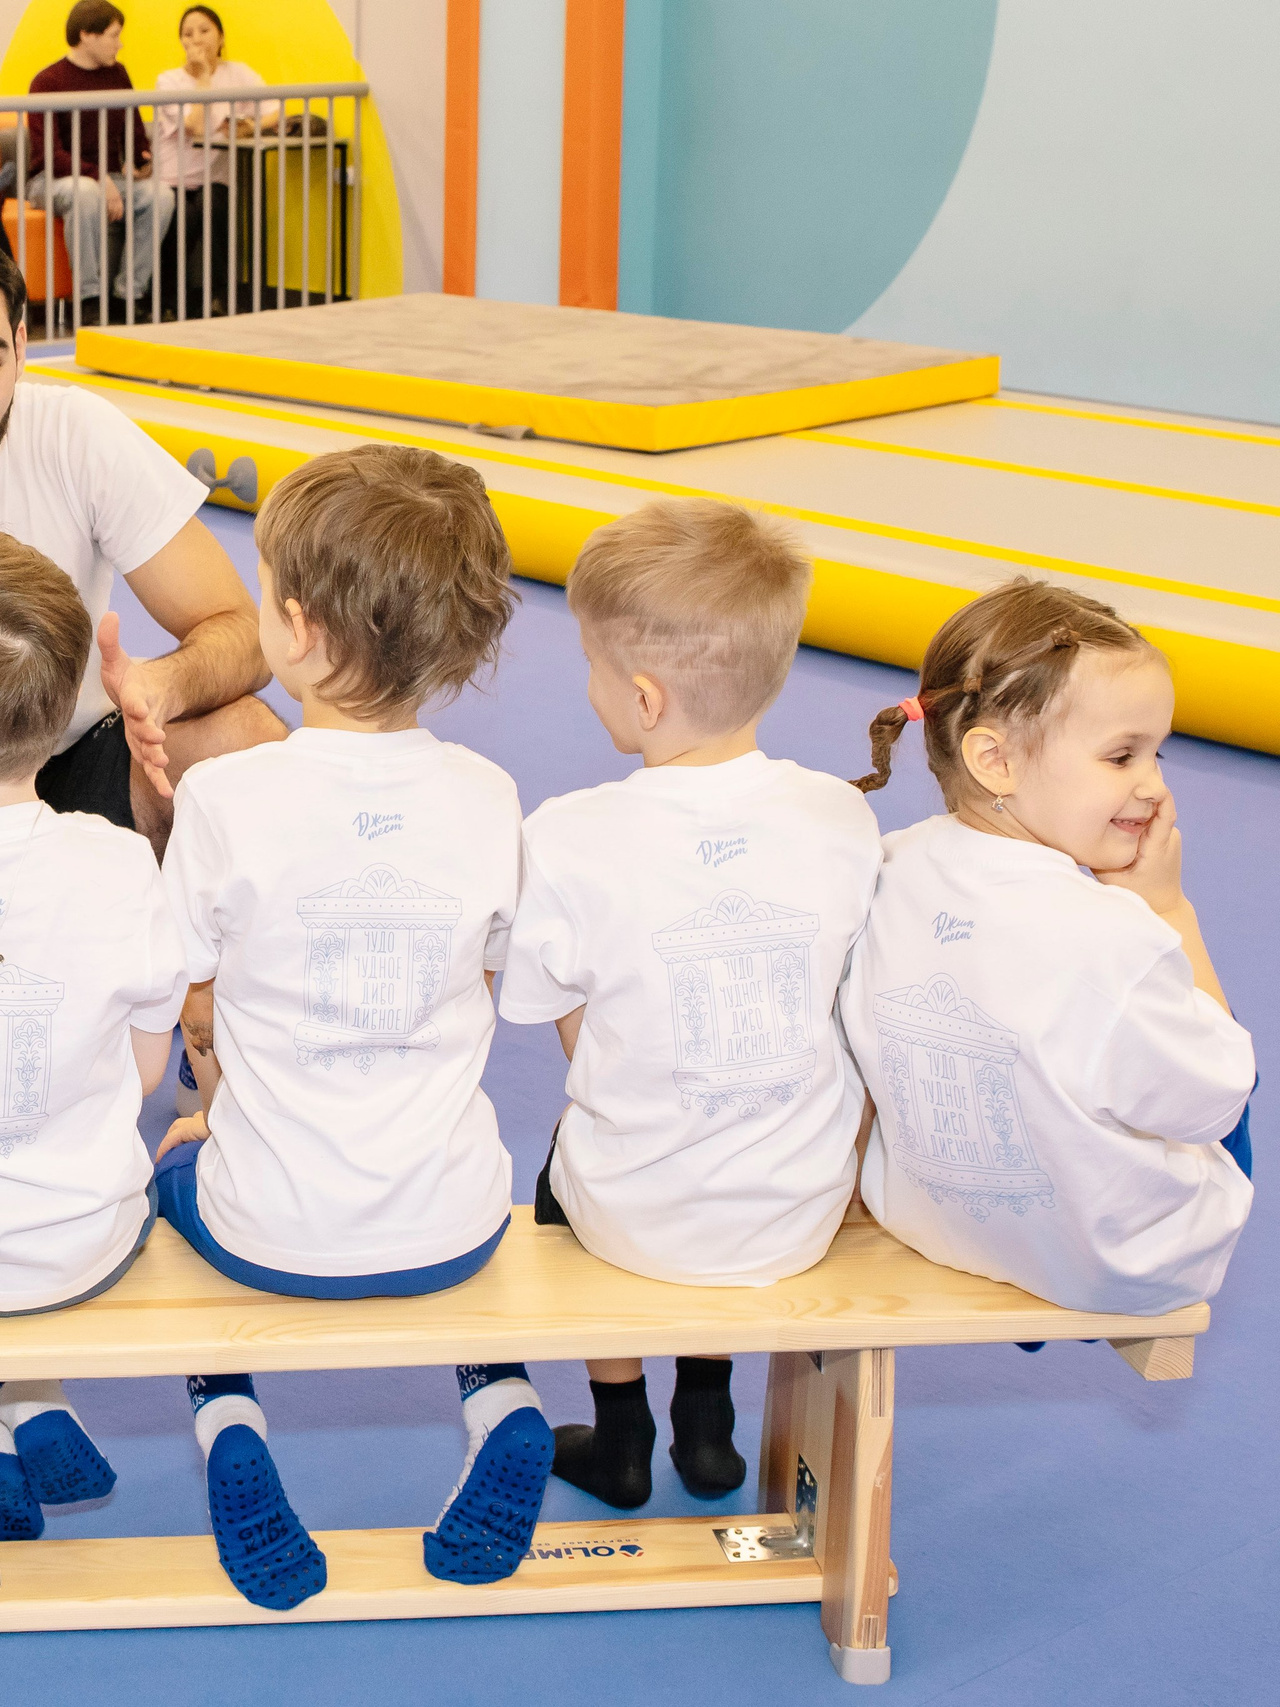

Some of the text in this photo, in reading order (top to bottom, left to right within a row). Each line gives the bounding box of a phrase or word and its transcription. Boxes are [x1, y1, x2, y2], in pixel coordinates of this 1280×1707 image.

[364, 931, 395, 954] ЧУДО
[354, 955, 402, 979] ЧУДНОЕ
[722, 956, 754, 981] ЧУДО
[719, 980, 764, 1009] ЧУДНОЕ
[925, 1051, 958, 1081] ЧУДО
[919, 1078, 970, 1112] ЧУДНОЕ
[238, 1510, 282, 1541] GYM
[489, 1501, 534, 1533] GYM
